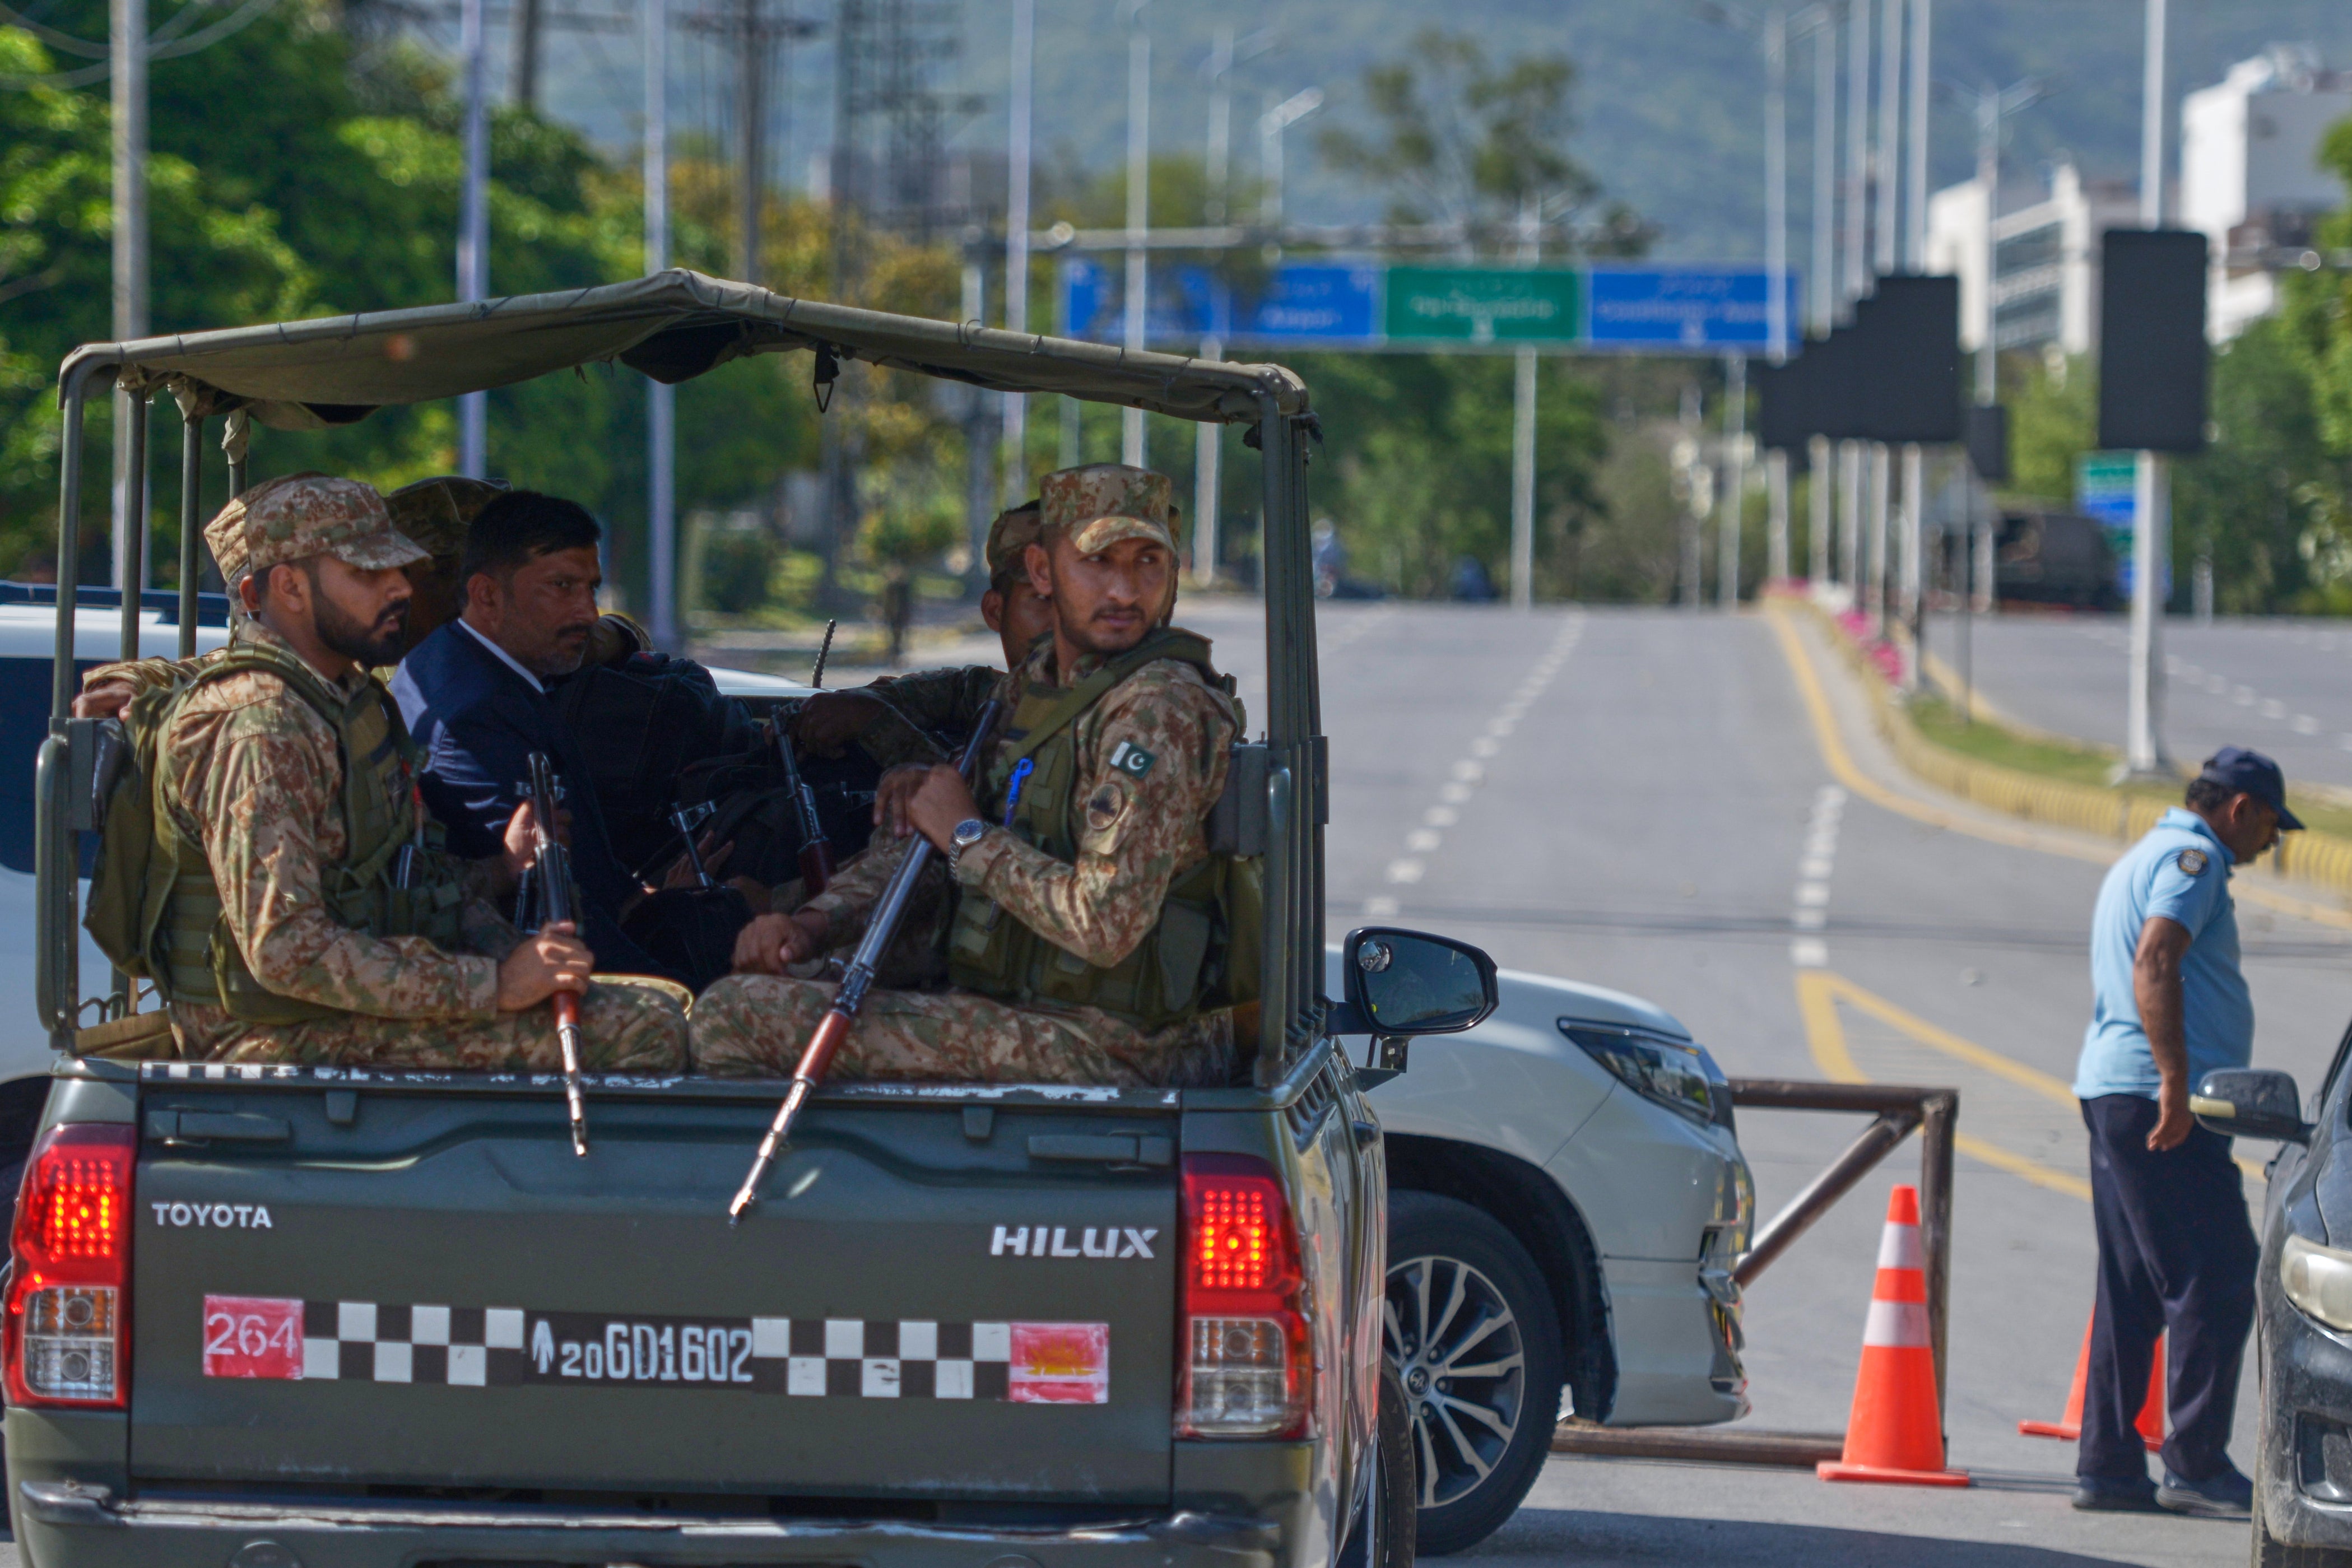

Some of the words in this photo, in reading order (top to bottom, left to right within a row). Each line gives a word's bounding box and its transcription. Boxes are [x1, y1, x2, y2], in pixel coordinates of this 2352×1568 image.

[152, 1203, 272, 1228] TOYOTA
[990, 1226, 1158, 1258] HILUX
[206, 1313, 298, 1358] 264
